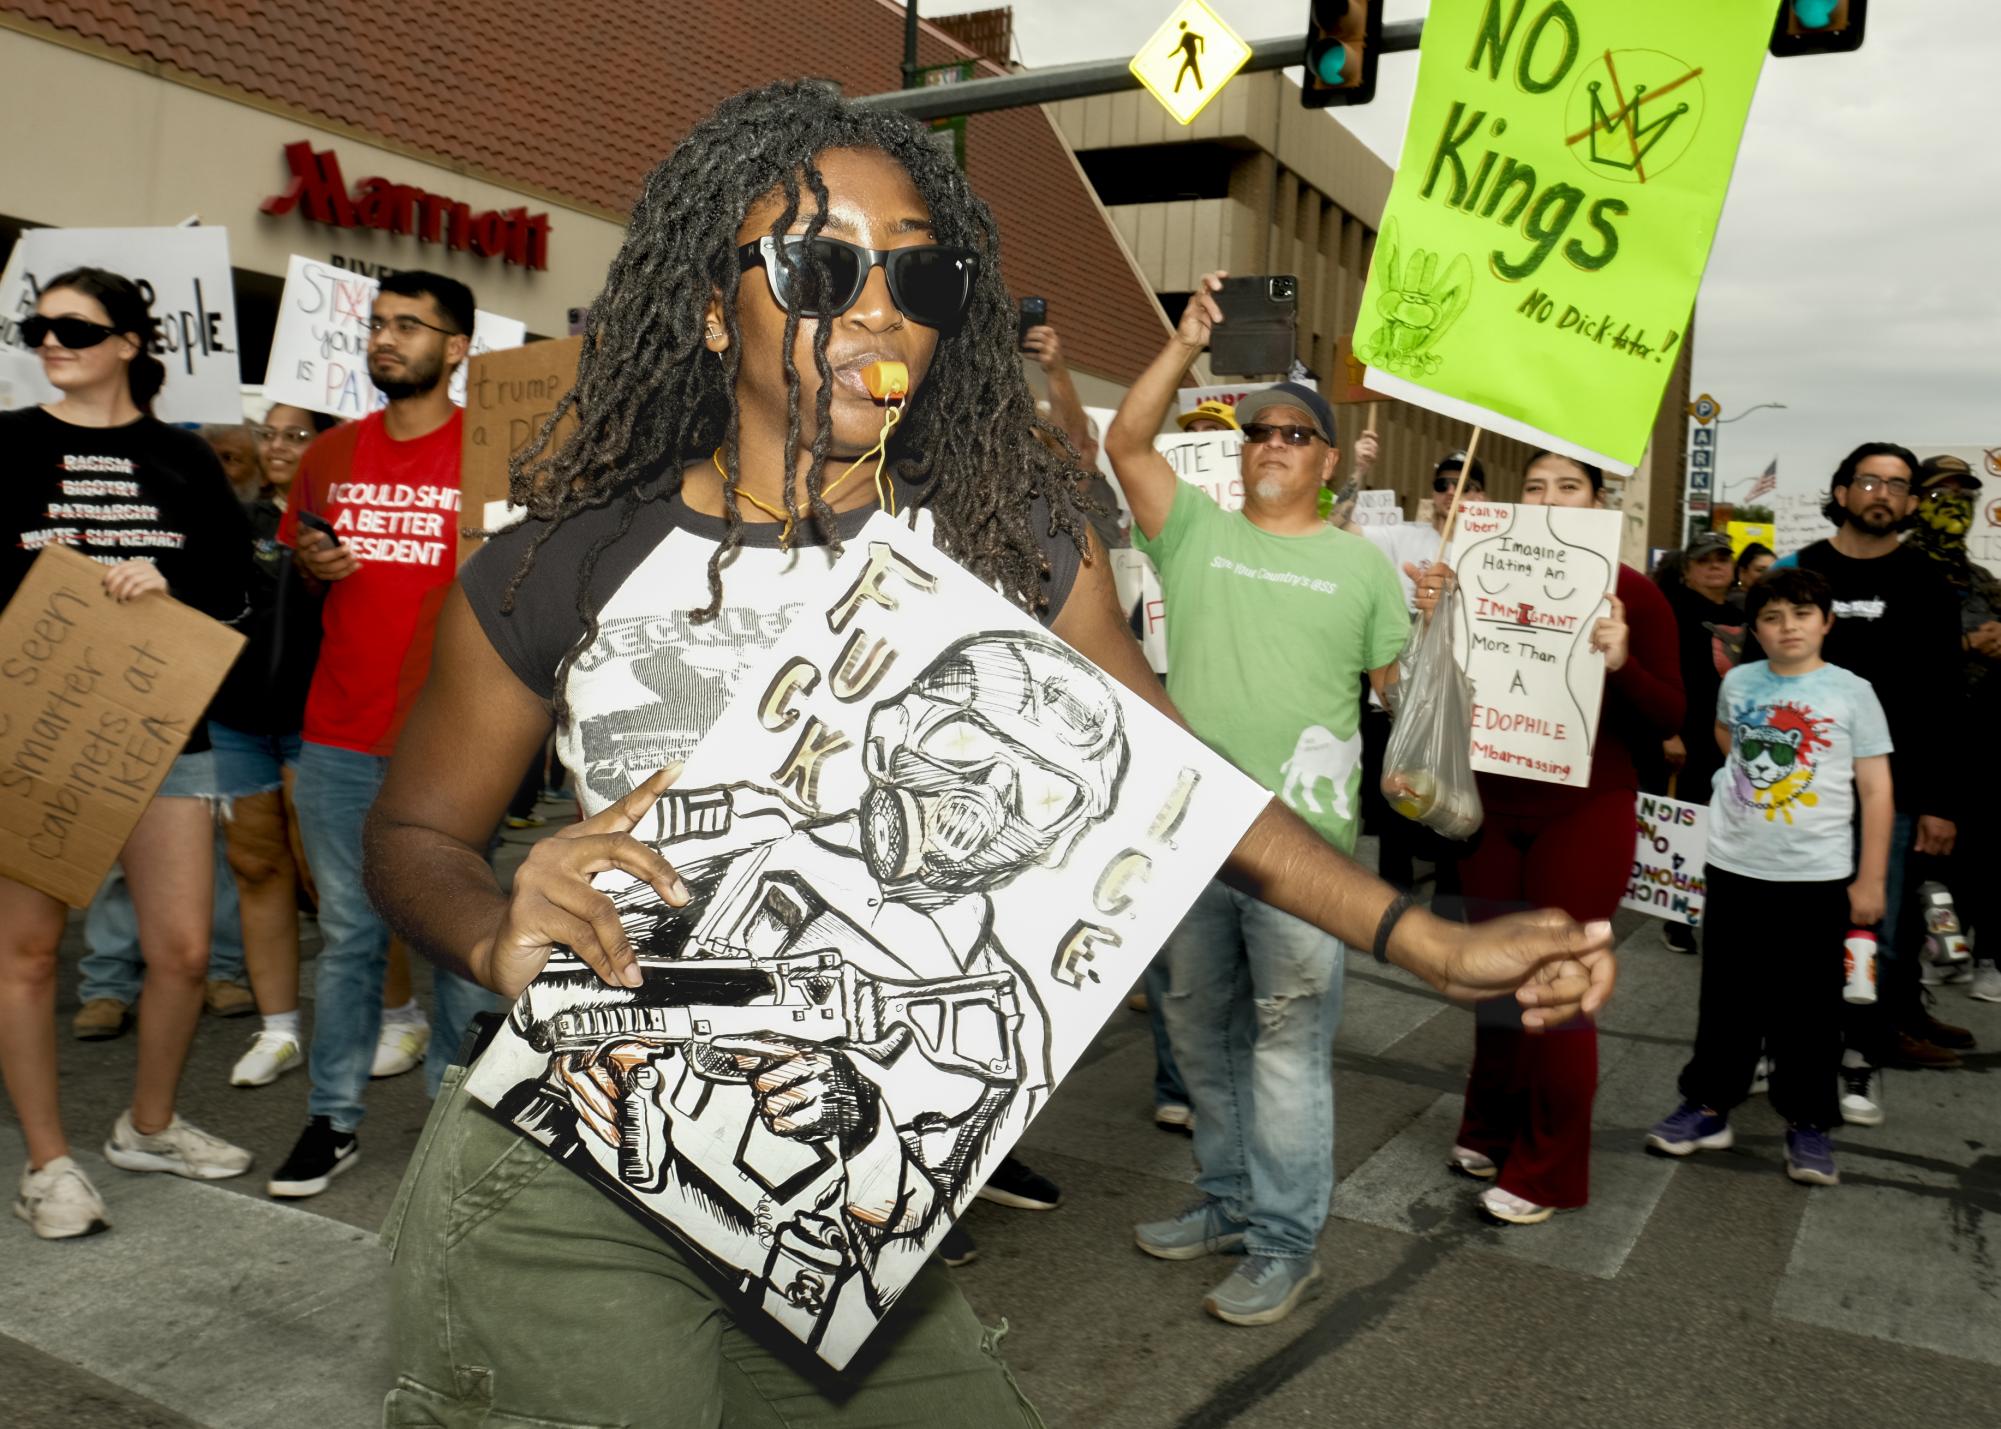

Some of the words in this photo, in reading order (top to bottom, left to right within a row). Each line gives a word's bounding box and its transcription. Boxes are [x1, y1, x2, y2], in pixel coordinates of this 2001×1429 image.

[1466, 0, 1580, 94] NO
[259, 139, 552, 271] Marriott
[1419, 100, 1630, 281] Kings
[1516, 287, 1554, 324] NO
[473, 364, 560, 410] trump
[1165, 442, 1211, 474] OTE
[336, 483, 416, 505] COULD
[334, 509, 353, 530] A
[357, 511, 444, 536] BETTER
[338, 538, 448, 566] ESIDENT
[1482, 553, 1533, 577] Hating
[1498, 536, 1567, 562] Imagine
[1471, 632, 1511, 655] More
[1518, 641, 1556, 664] Than
[123, 640, 168, 694] at
[1509, 669, 1528, 696] A
[1, 646, 104, 798] smarter
[1471, 703, 1567, 740] EDOPHILE
[102, 715, 186, 804] IKEA
[1470, 740, 1572, 782] Mbarrassing
[1641, 798, 1696, 827] SIGN
